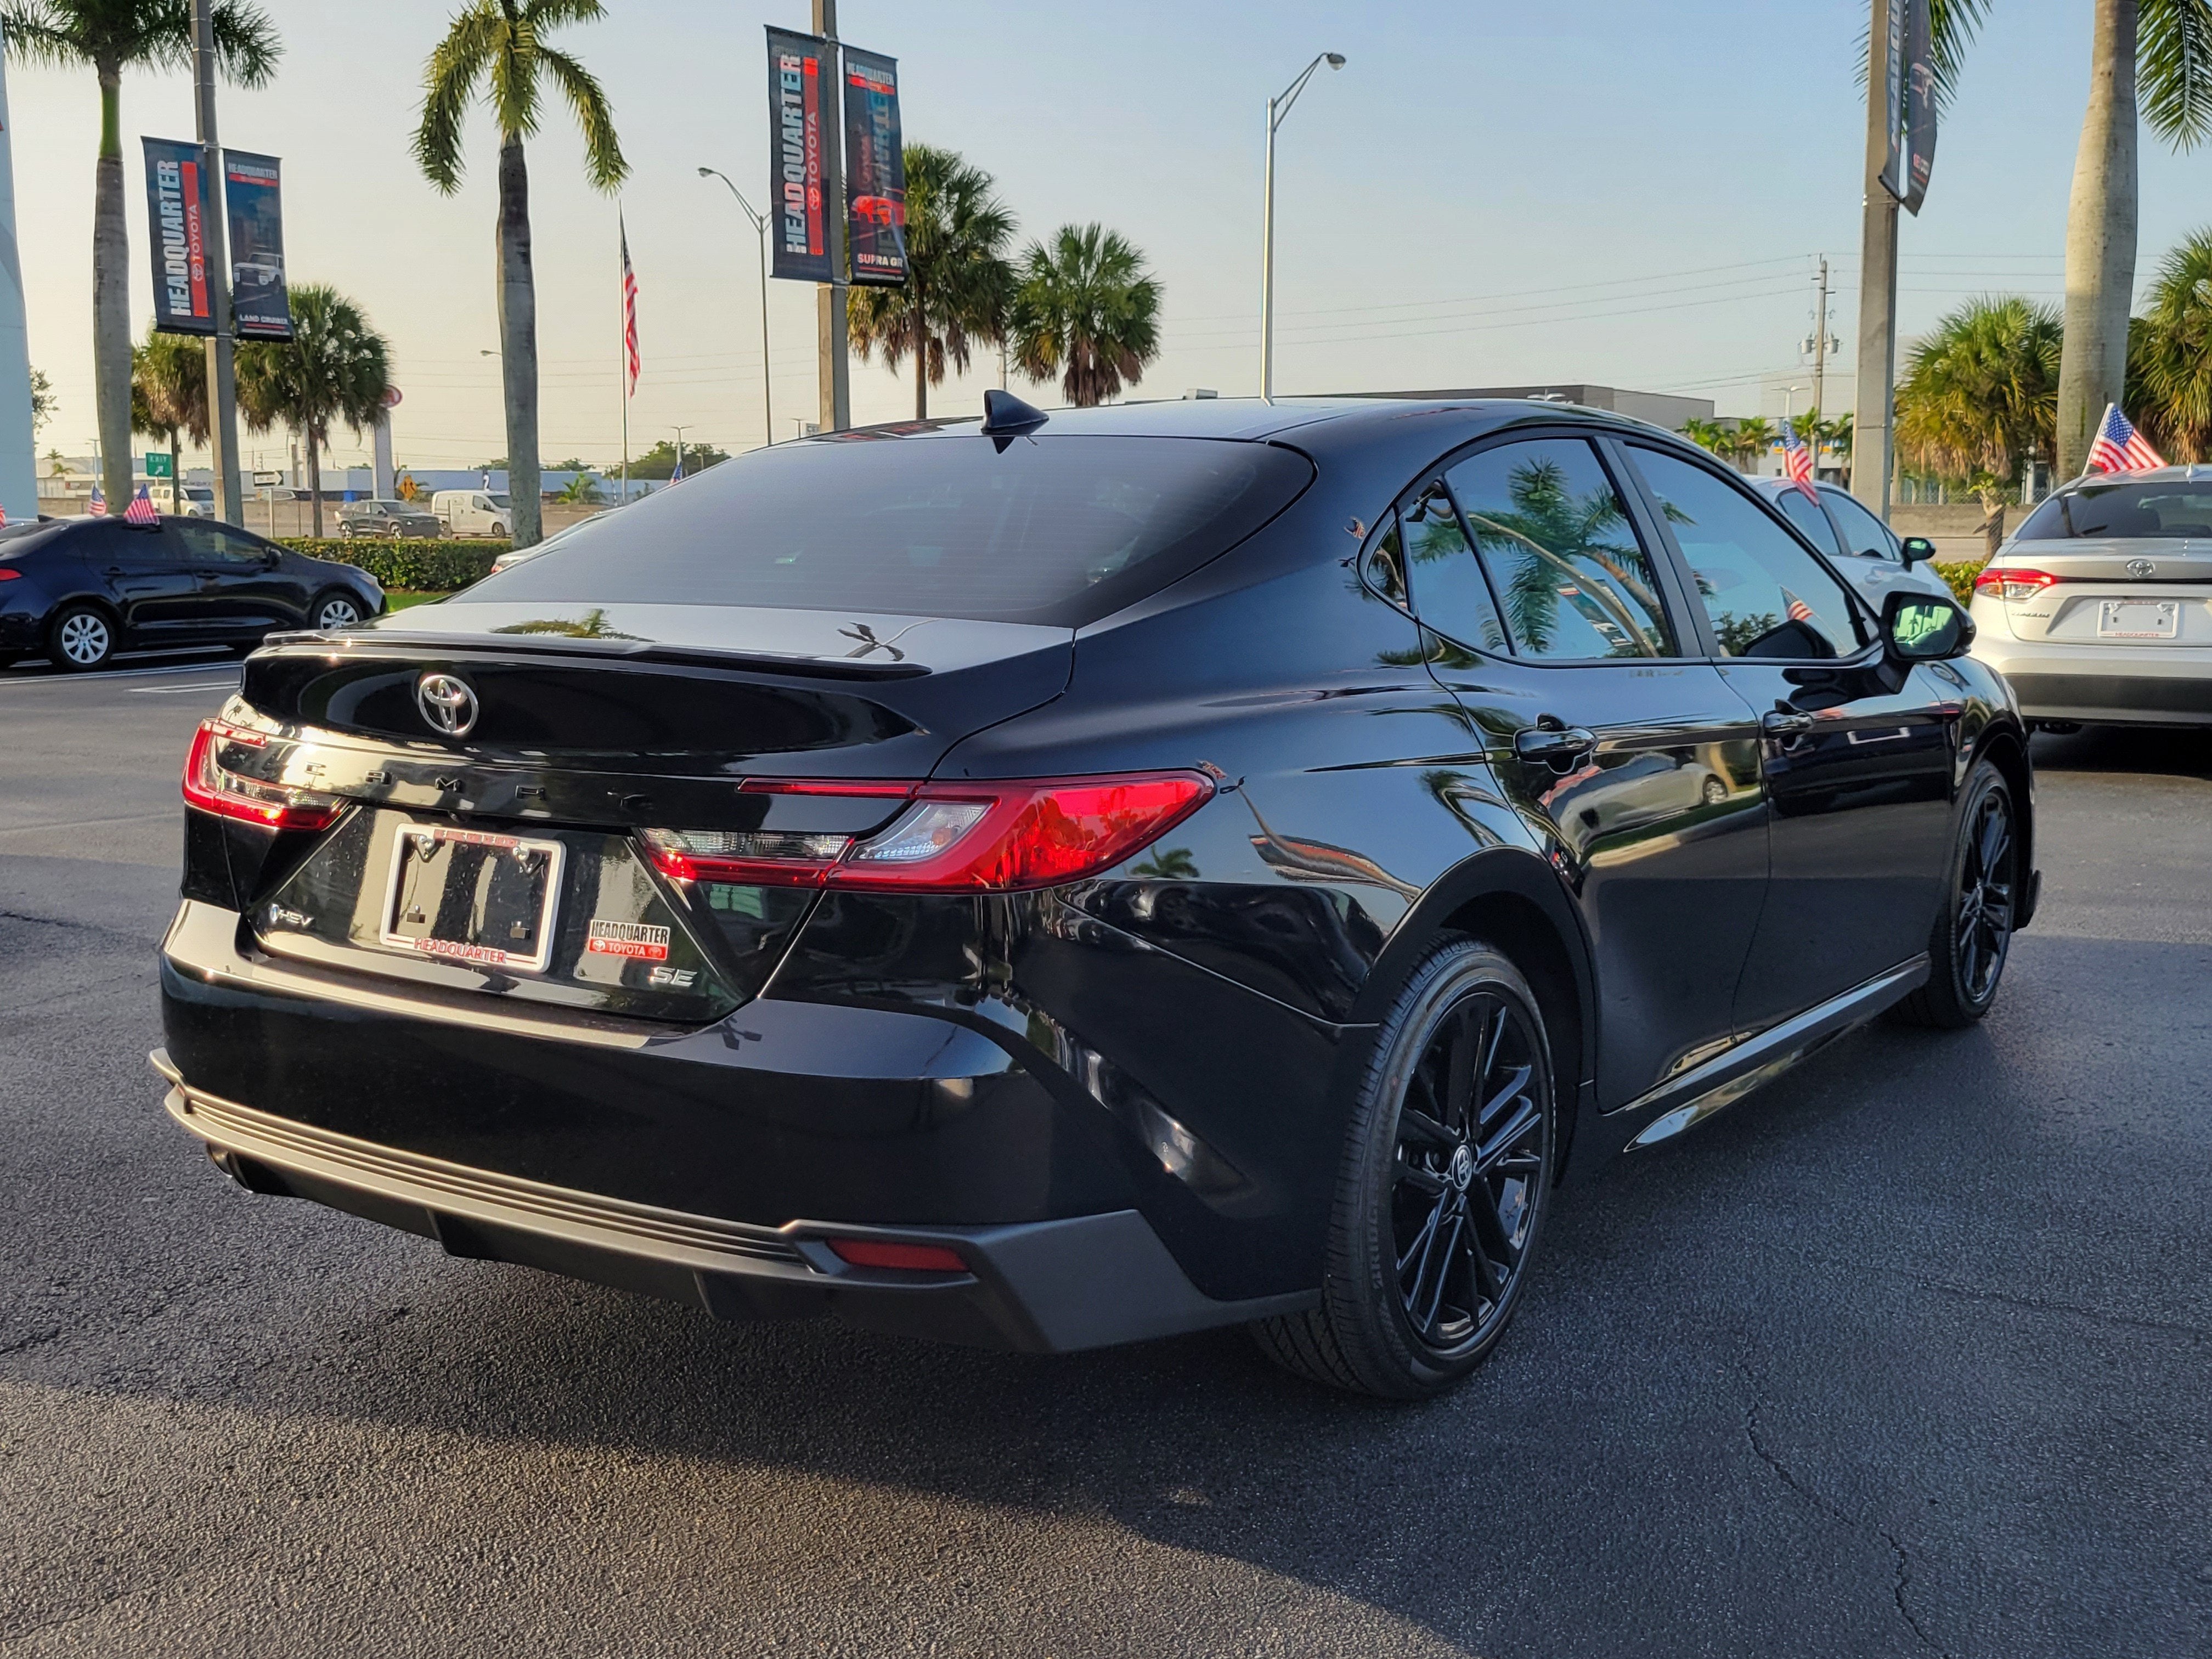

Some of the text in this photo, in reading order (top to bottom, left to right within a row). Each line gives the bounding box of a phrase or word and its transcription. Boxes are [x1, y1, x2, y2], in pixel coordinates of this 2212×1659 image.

[780, 54, 807, 255] HEADQUARTER
[808, 112, 819, 185] TOYOTA
[157, 160, 191, 315] HEADQUARTER
[188, 204, 201, 261] TOYOTA
[857, 253, 903, 268] SUPRA GR
[279, 909, 316, 928] HEV
[591, 921, 668, 945] HEADQUARTER
[414, 937, 507, 964] HEADQUARTER
[608, 943, 646, 957] TOYOTA
[648, 966, 698, 988] SE
